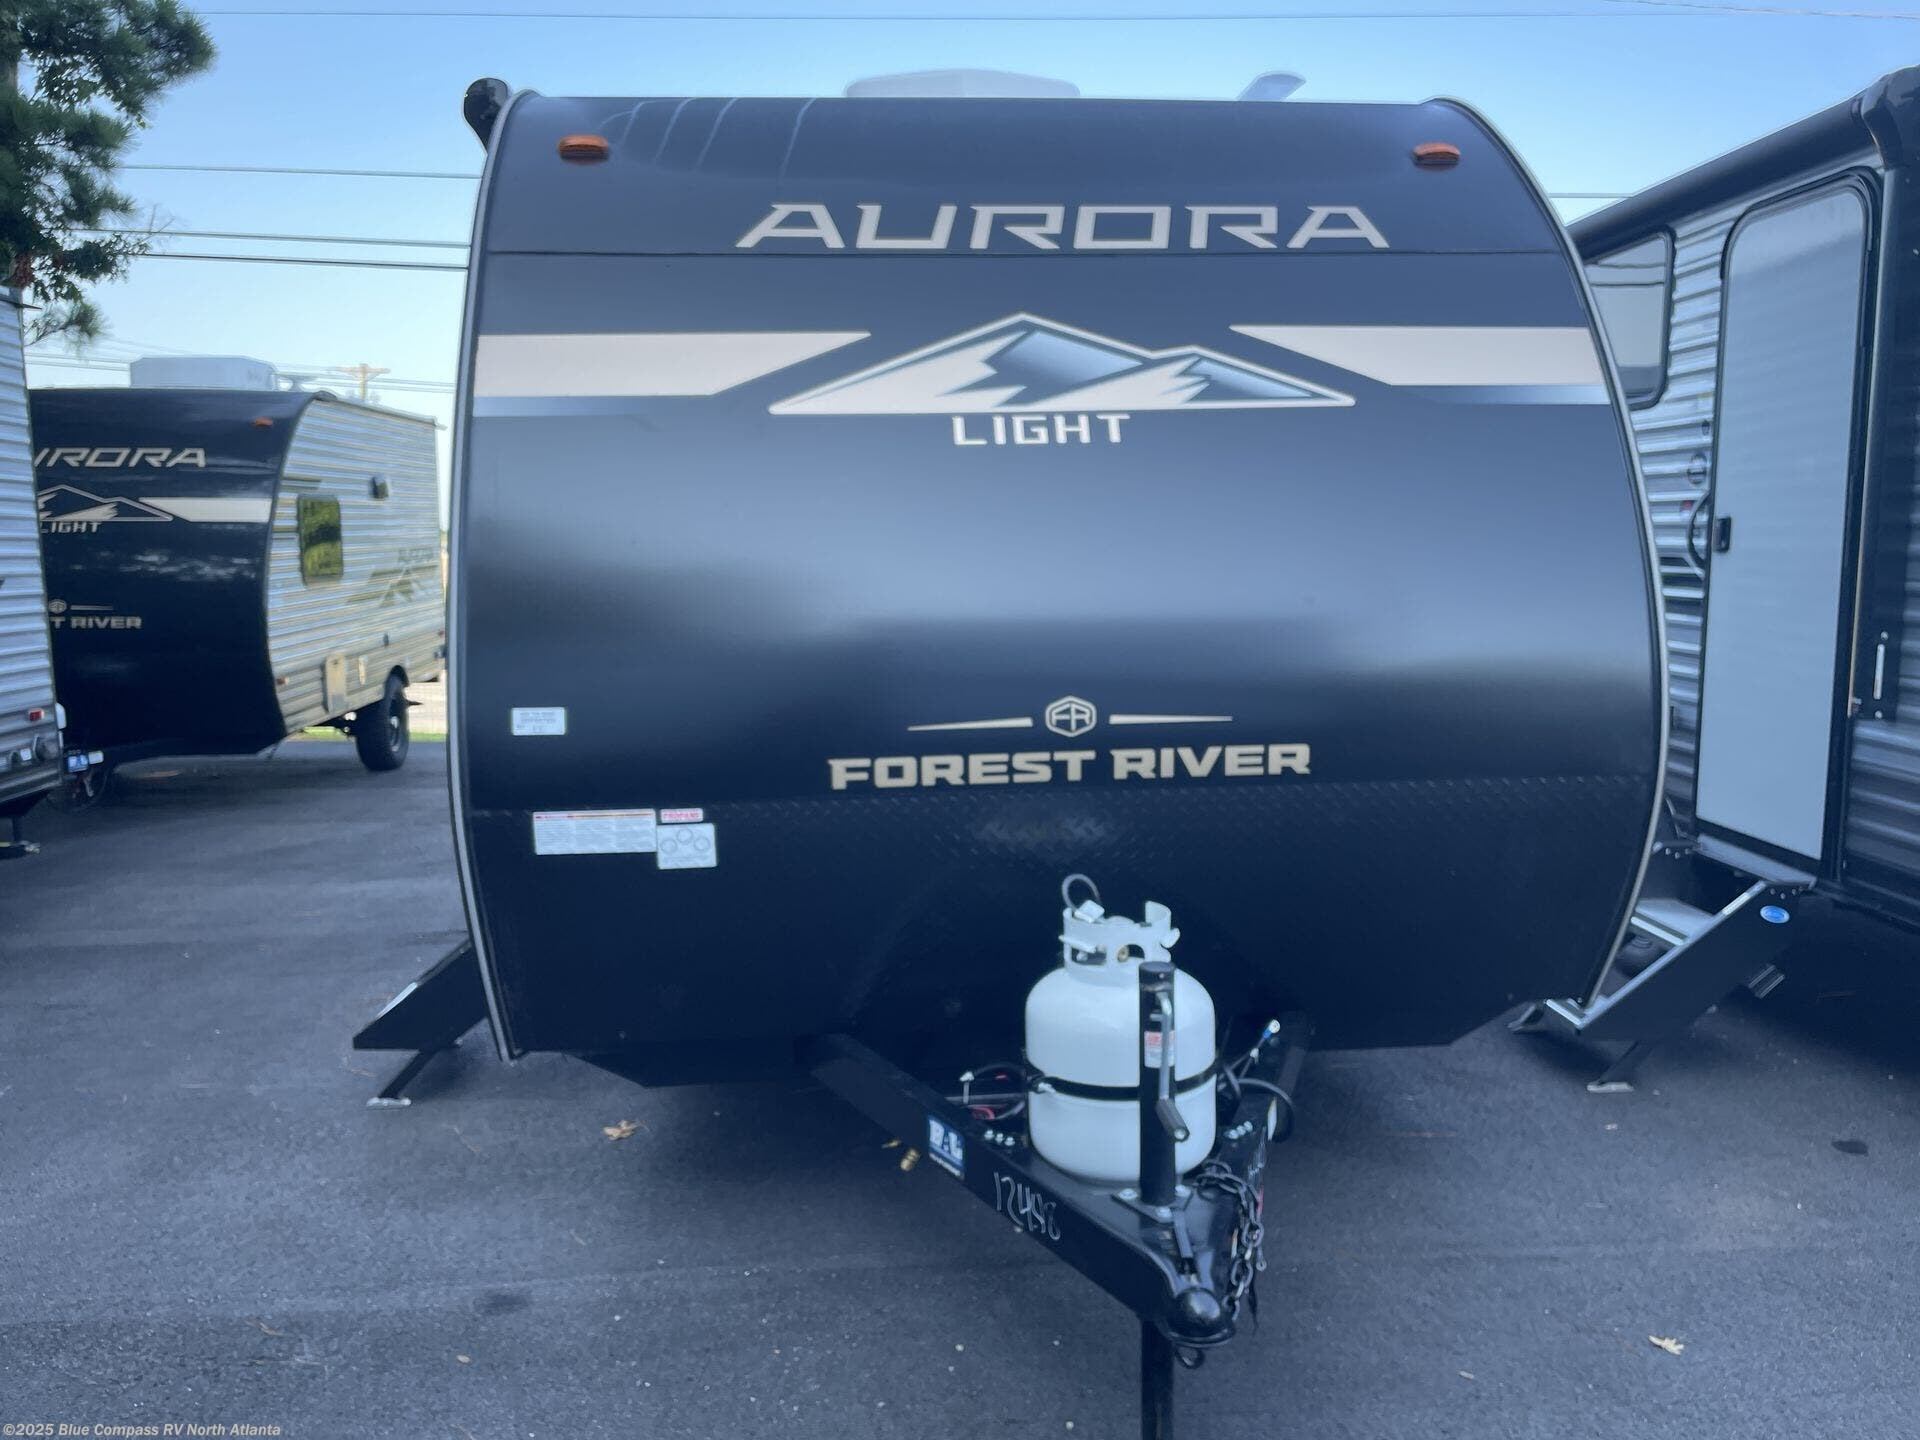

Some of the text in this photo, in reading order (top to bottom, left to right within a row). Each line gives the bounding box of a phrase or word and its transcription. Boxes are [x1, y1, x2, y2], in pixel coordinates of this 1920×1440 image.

[735, 203, 1390, 249] AURORA
[952, 414, 1130, 445] LIGHT
[39, 521, 103, 533] LIGHT
[70, 616, 143, 629] RIVER
[827, 743, 1311, 790] FOREST RIVER
